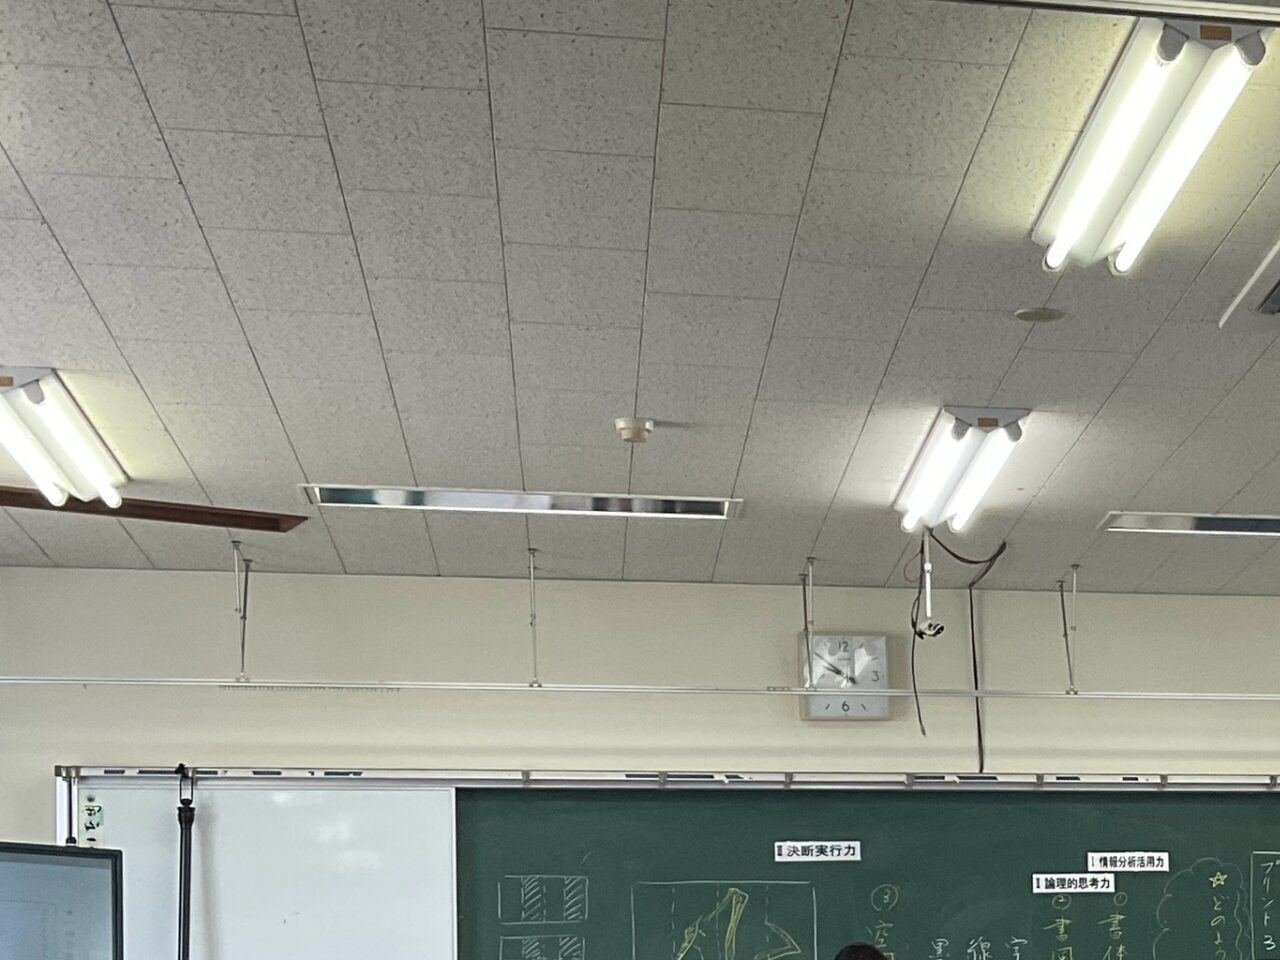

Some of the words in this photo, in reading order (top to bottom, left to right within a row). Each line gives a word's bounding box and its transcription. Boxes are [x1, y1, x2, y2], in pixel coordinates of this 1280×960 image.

[838, 640, 849, 653] 12
[870, 670, 880, 682] 3
[841, 700, 850, 712] 6
